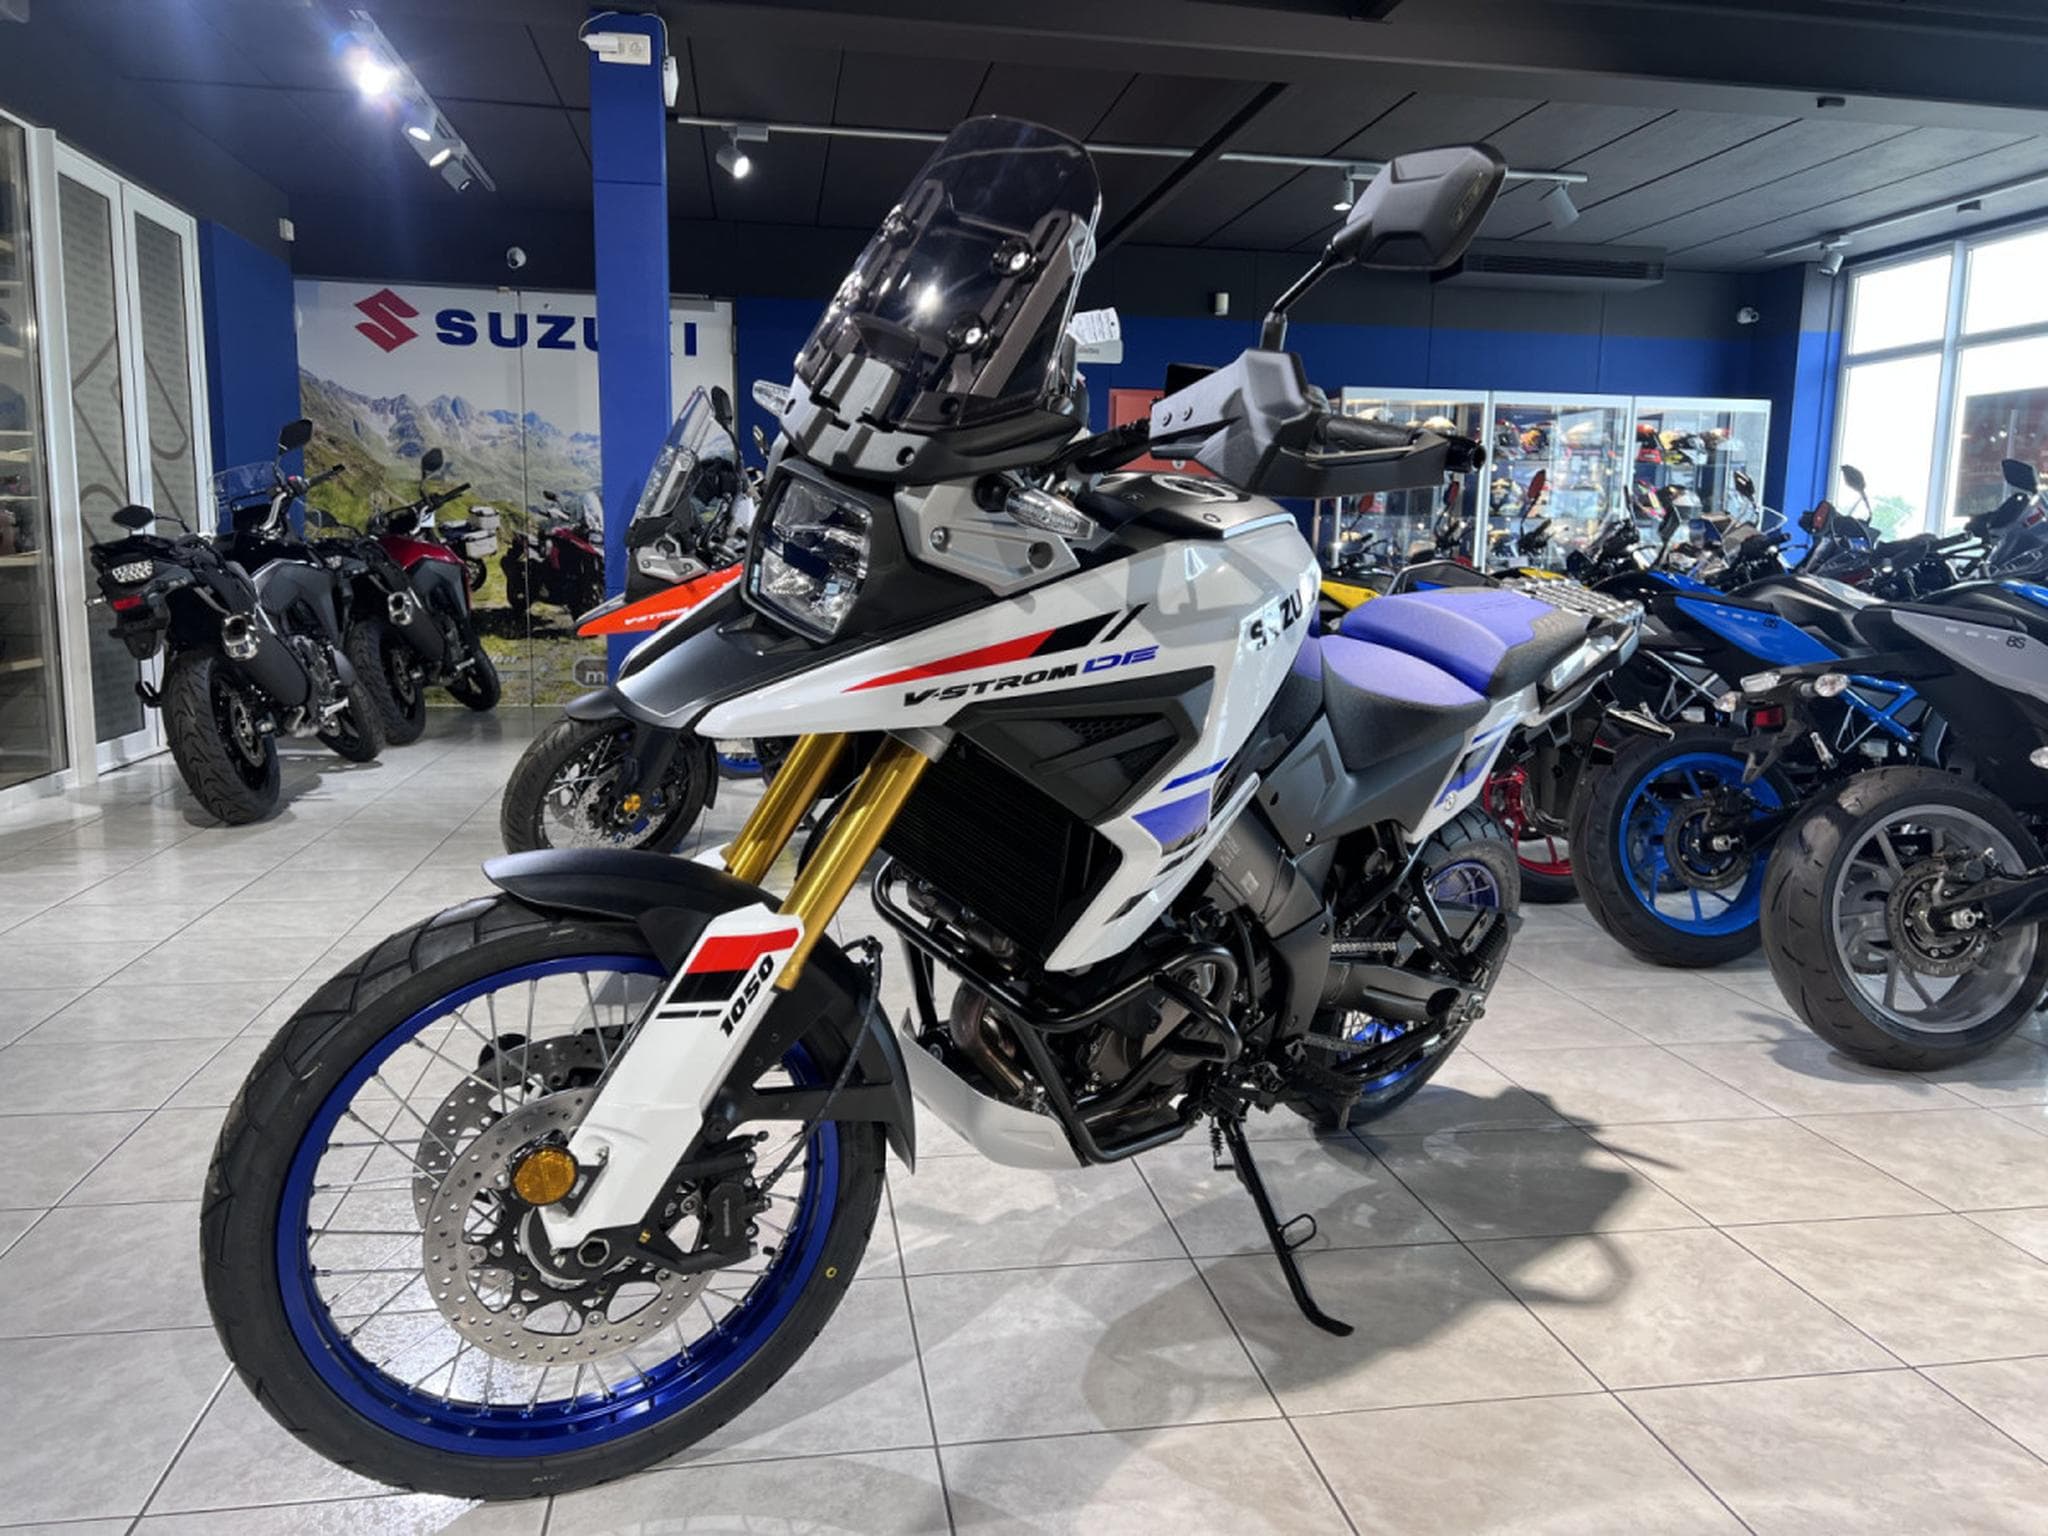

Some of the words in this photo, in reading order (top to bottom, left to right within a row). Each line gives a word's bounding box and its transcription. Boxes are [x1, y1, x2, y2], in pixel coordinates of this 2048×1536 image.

[435, 309, 697, 356] SUZI
[904, 664, 1078, 706] V-STROM
[1082, 645, 1159, 673] DE
[720, 954, 774, 1037] 1050
